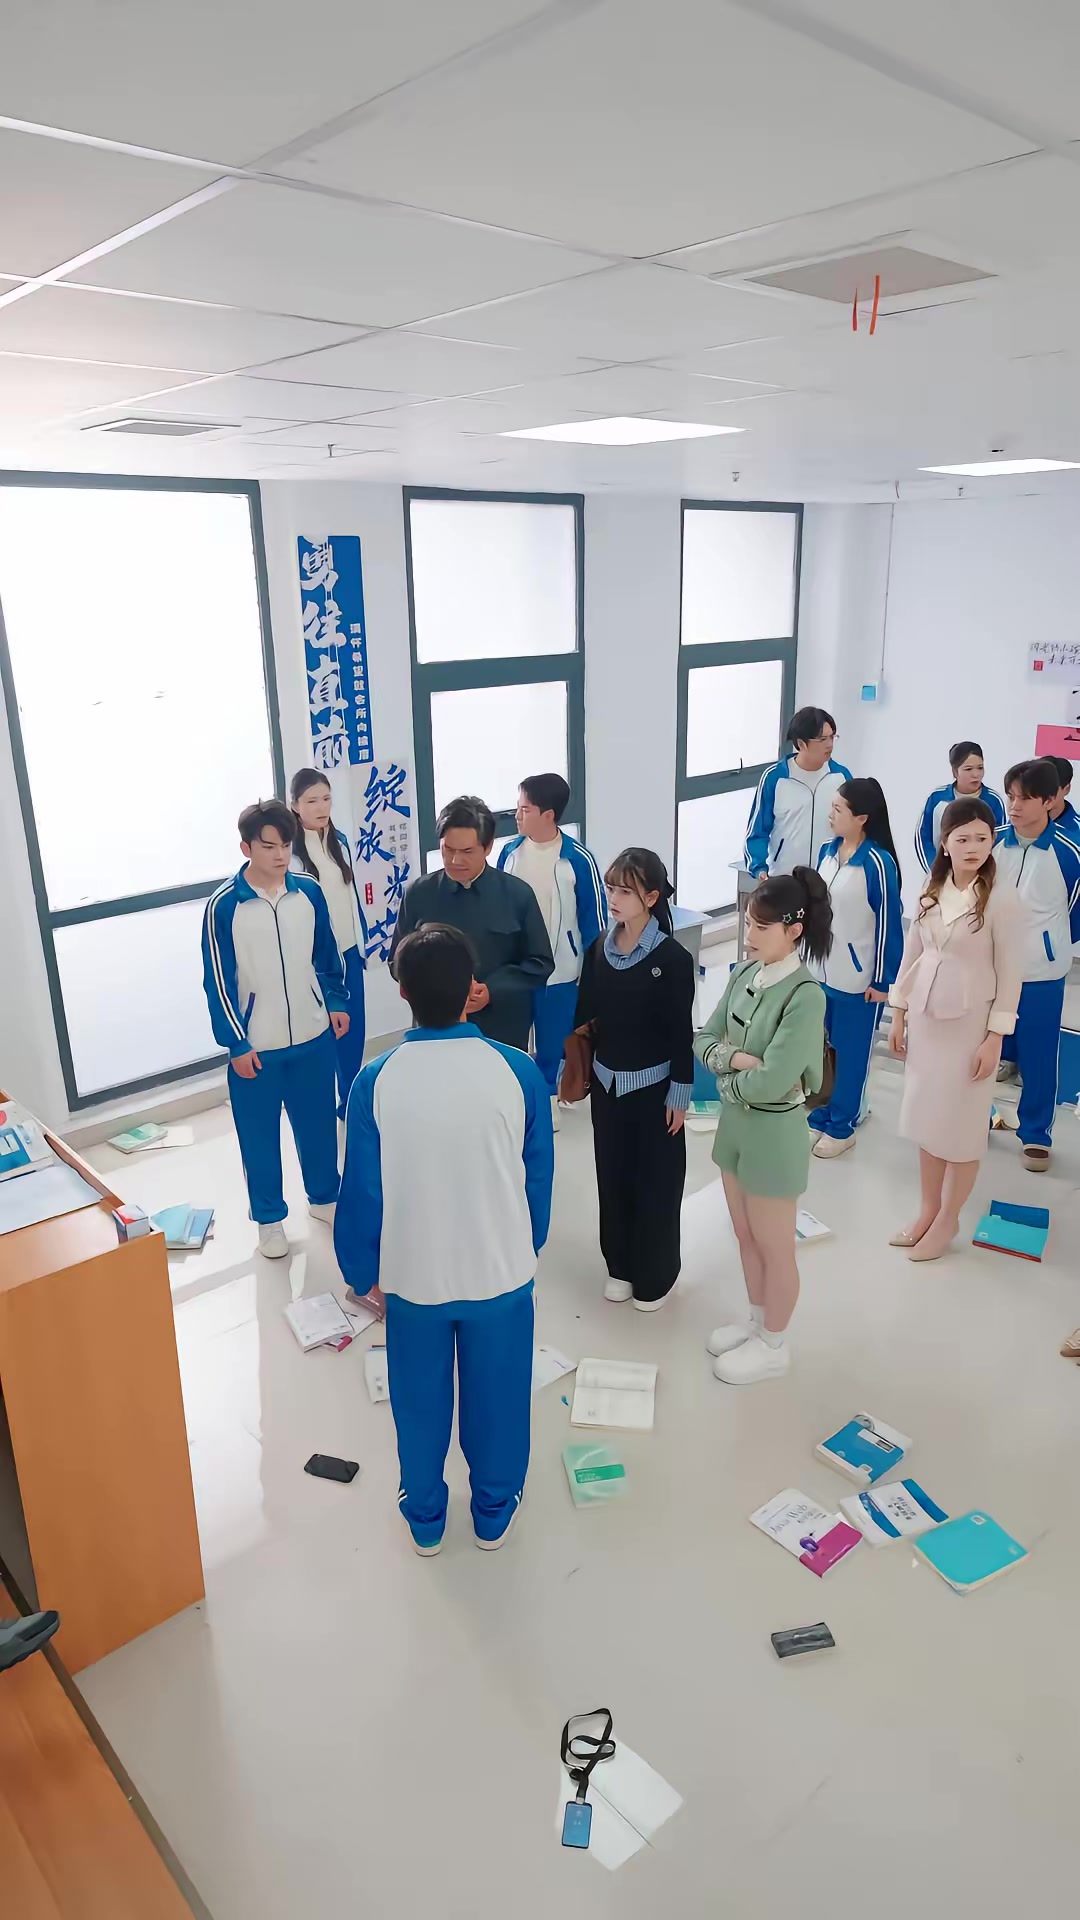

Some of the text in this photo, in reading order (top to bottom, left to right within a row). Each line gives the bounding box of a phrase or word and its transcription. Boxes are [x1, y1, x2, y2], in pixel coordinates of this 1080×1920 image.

[300, 536, 350, 768] 勇往直前
[356, 764, 411, 963] 绽放光芒
